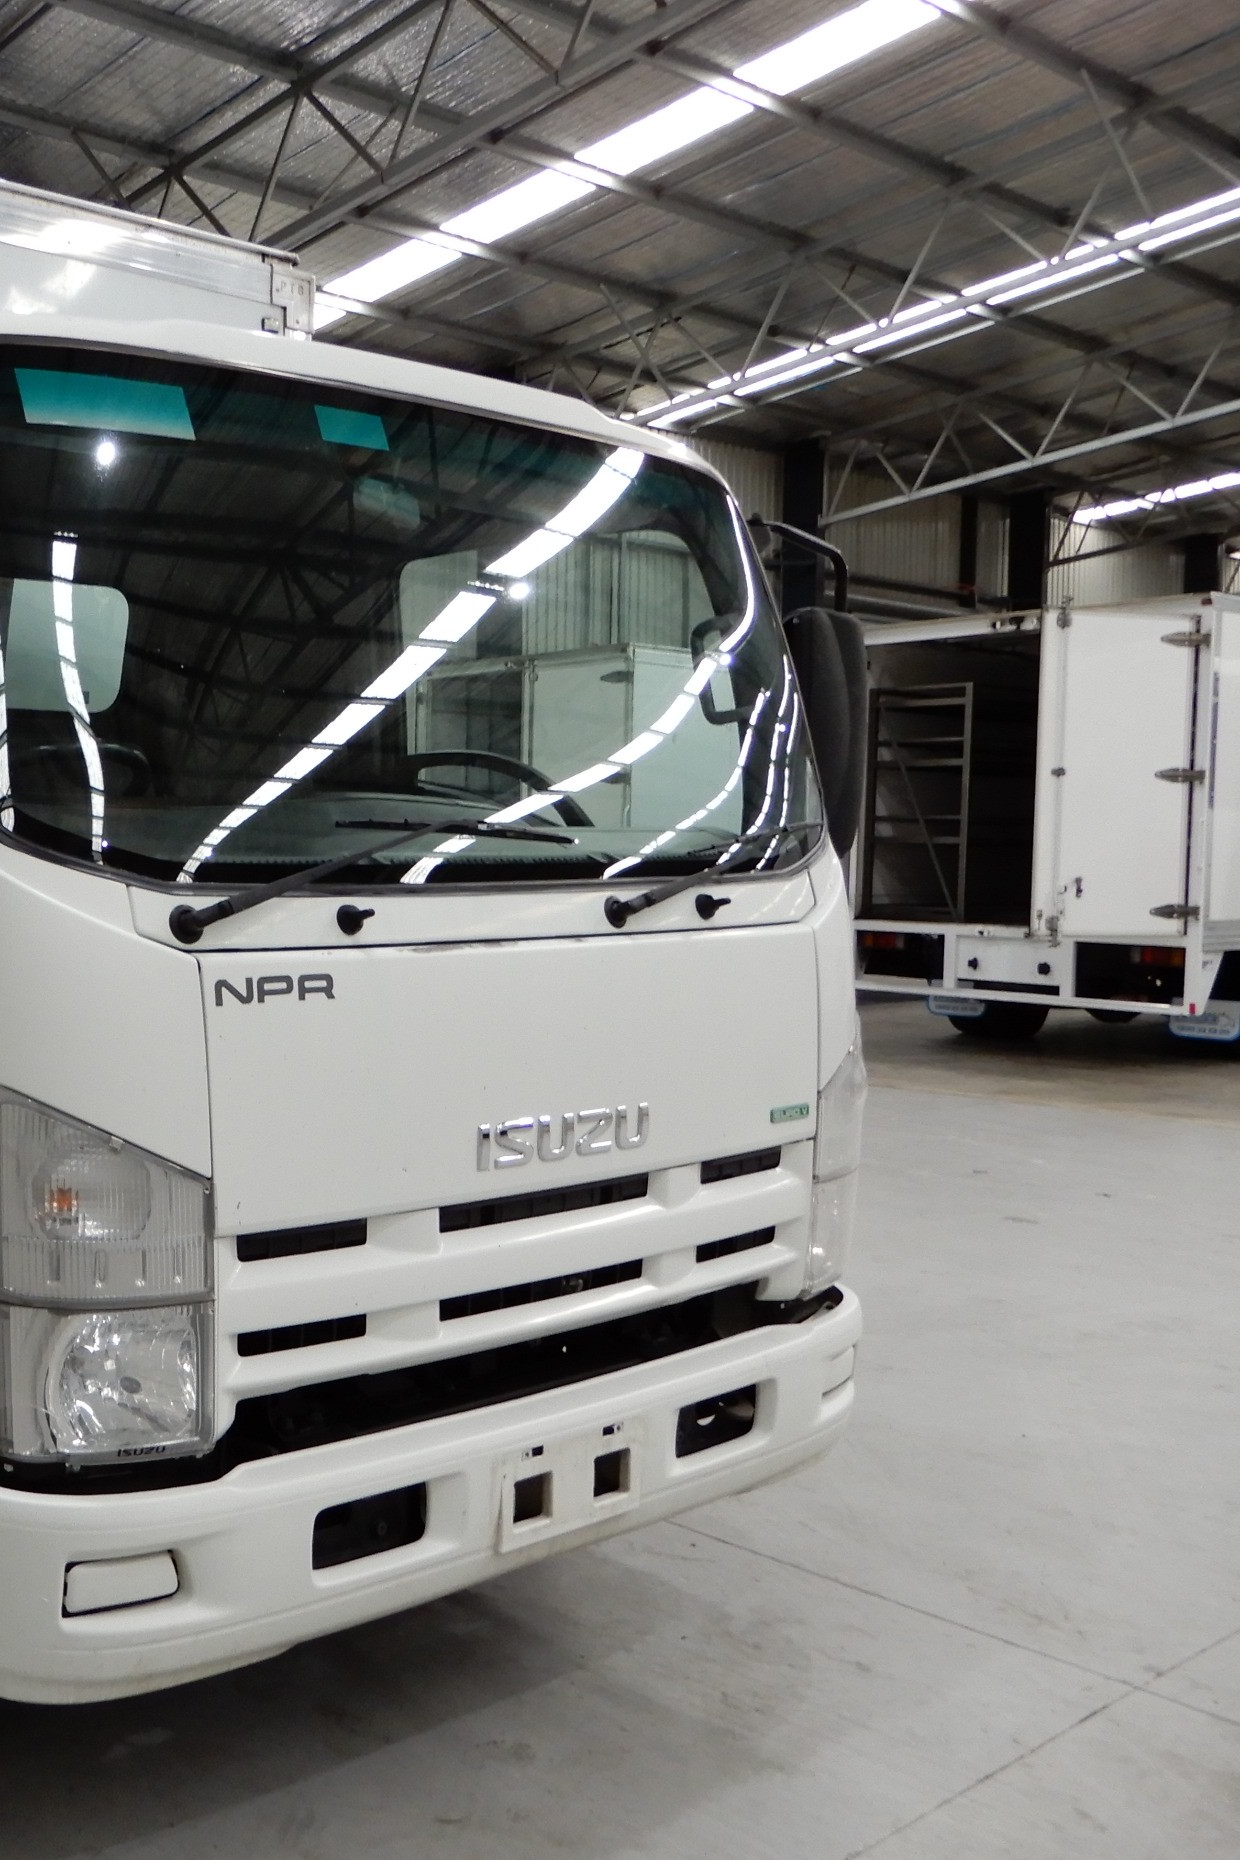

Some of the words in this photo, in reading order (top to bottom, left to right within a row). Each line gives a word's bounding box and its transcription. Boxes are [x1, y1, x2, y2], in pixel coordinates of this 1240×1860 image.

[214, 973, 336, 1007] NPR
[476, 1102, 650, 1173] ISUZU
[117, 1445, 166, 1457] ISUZU
